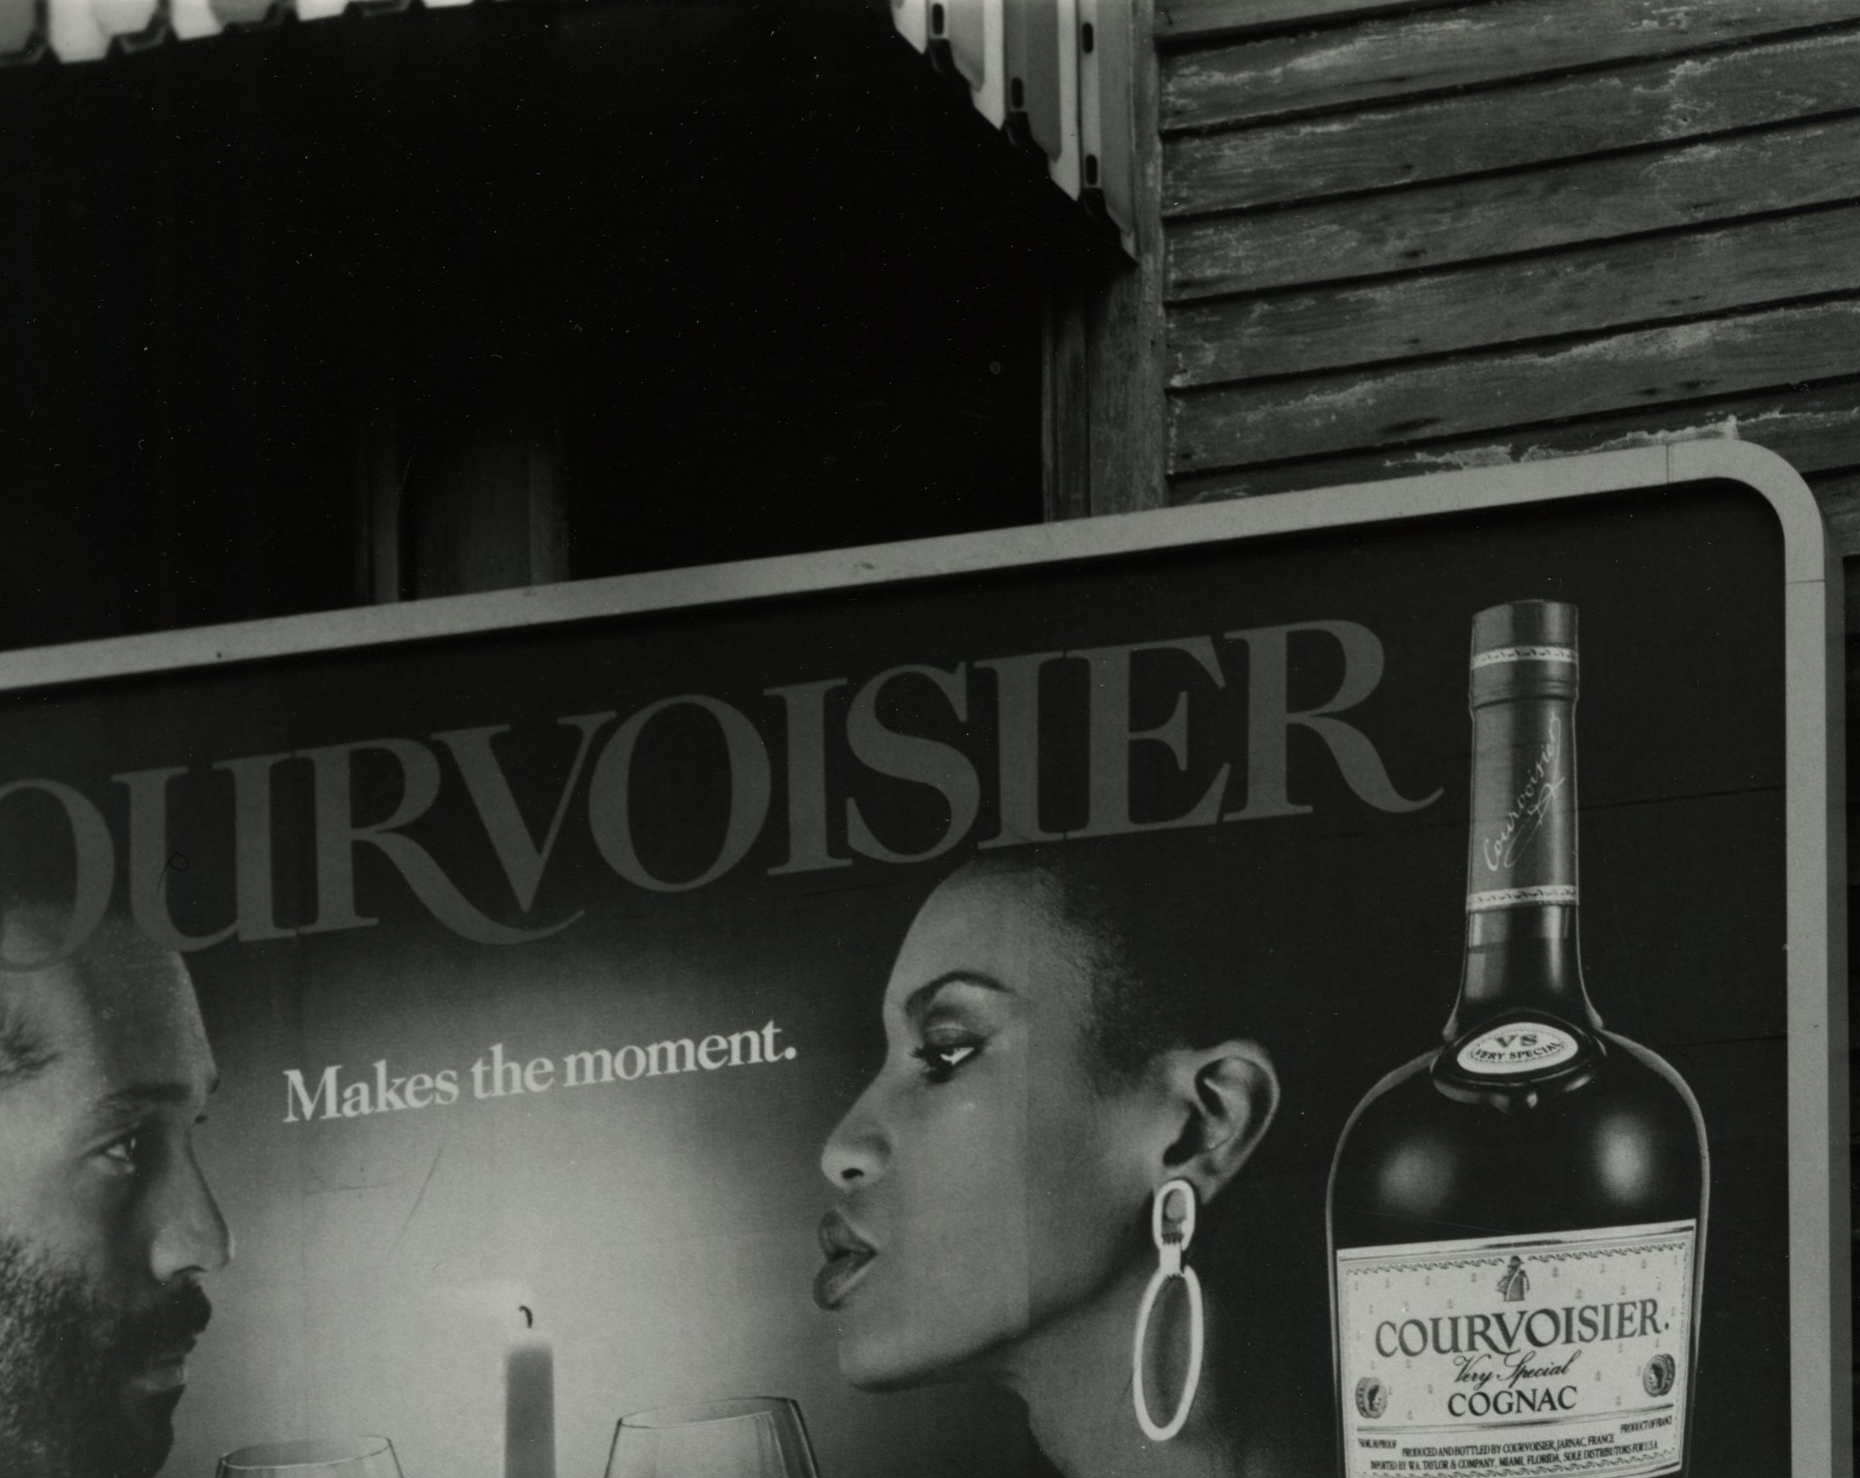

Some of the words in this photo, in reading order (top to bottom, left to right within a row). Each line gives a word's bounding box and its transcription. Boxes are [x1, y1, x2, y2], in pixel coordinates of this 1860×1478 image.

[1509, 1041, 1561, 1060] SPECIAL
[282, 1060, 460, 1124] Makes
[470, 1044, 554, 1099] the
[563, 1020, 798, 1088] moment.
[1452, 1354, 1494, 1391] Very
[1494, 1349, 1582, 1389] Special
[1447, 1385, 1578, 1418] COGNAC
[1402, 1447, 1437, 1457] PRODUCED
[1439, 1446, 1454, 1456] AND
[1455, 1444, 1490, 1456] BOTTLED
[1491, 1443, 1501, 1454] BY
[1588, 1433, 1615, 1446] FRANCE
[1422, 1460, 1449, 1470] TAYLOR
[1450, 1459, 1456, 1469] &
[1563, 1450, 1582, 1461] SOLE
[1583, 1443, 1632, 1460] DISTRIBUTORS
[1632, 1441, 1644, 1453] FOR
